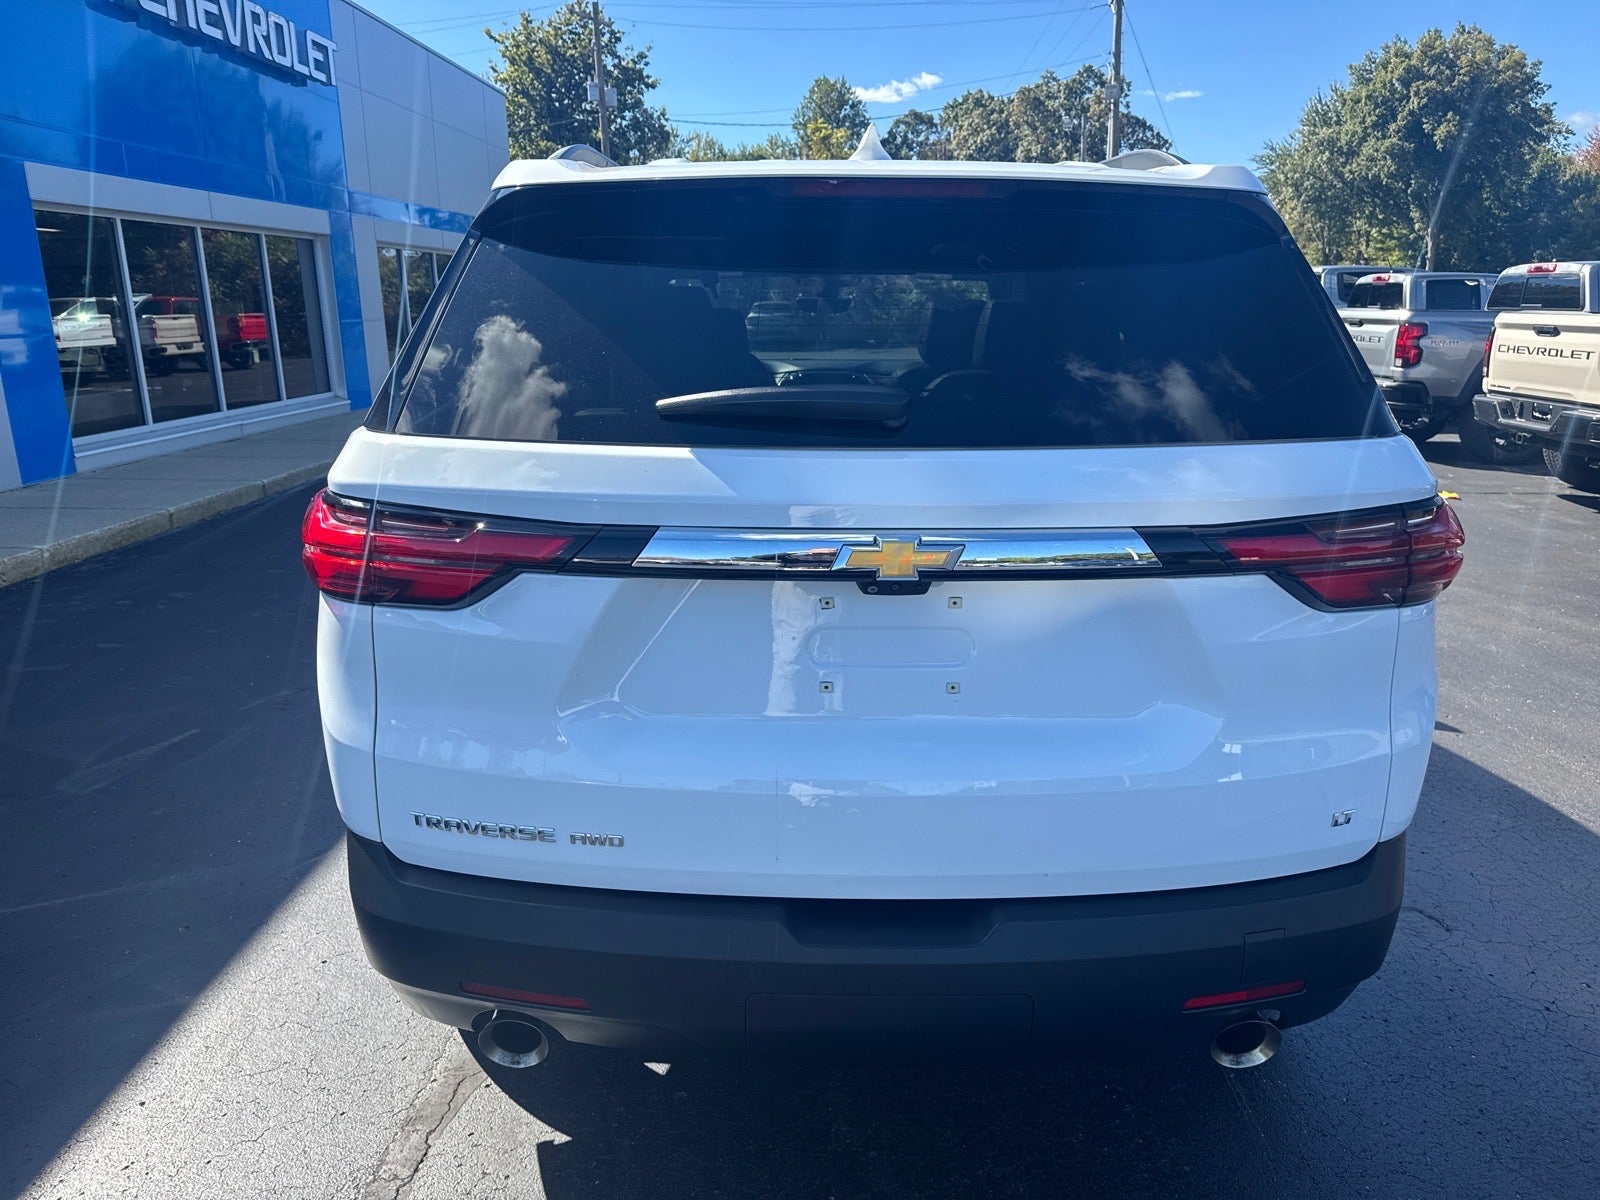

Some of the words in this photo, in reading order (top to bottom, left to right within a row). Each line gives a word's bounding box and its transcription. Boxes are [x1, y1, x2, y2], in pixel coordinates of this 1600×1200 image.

[1497, 344, 1596, 361] CHEVROLET
[1331, 808, 1357, 827] LT
[409, 811, 556, 843] TRAVERSE
[569, 831, 625, 848] AWD
